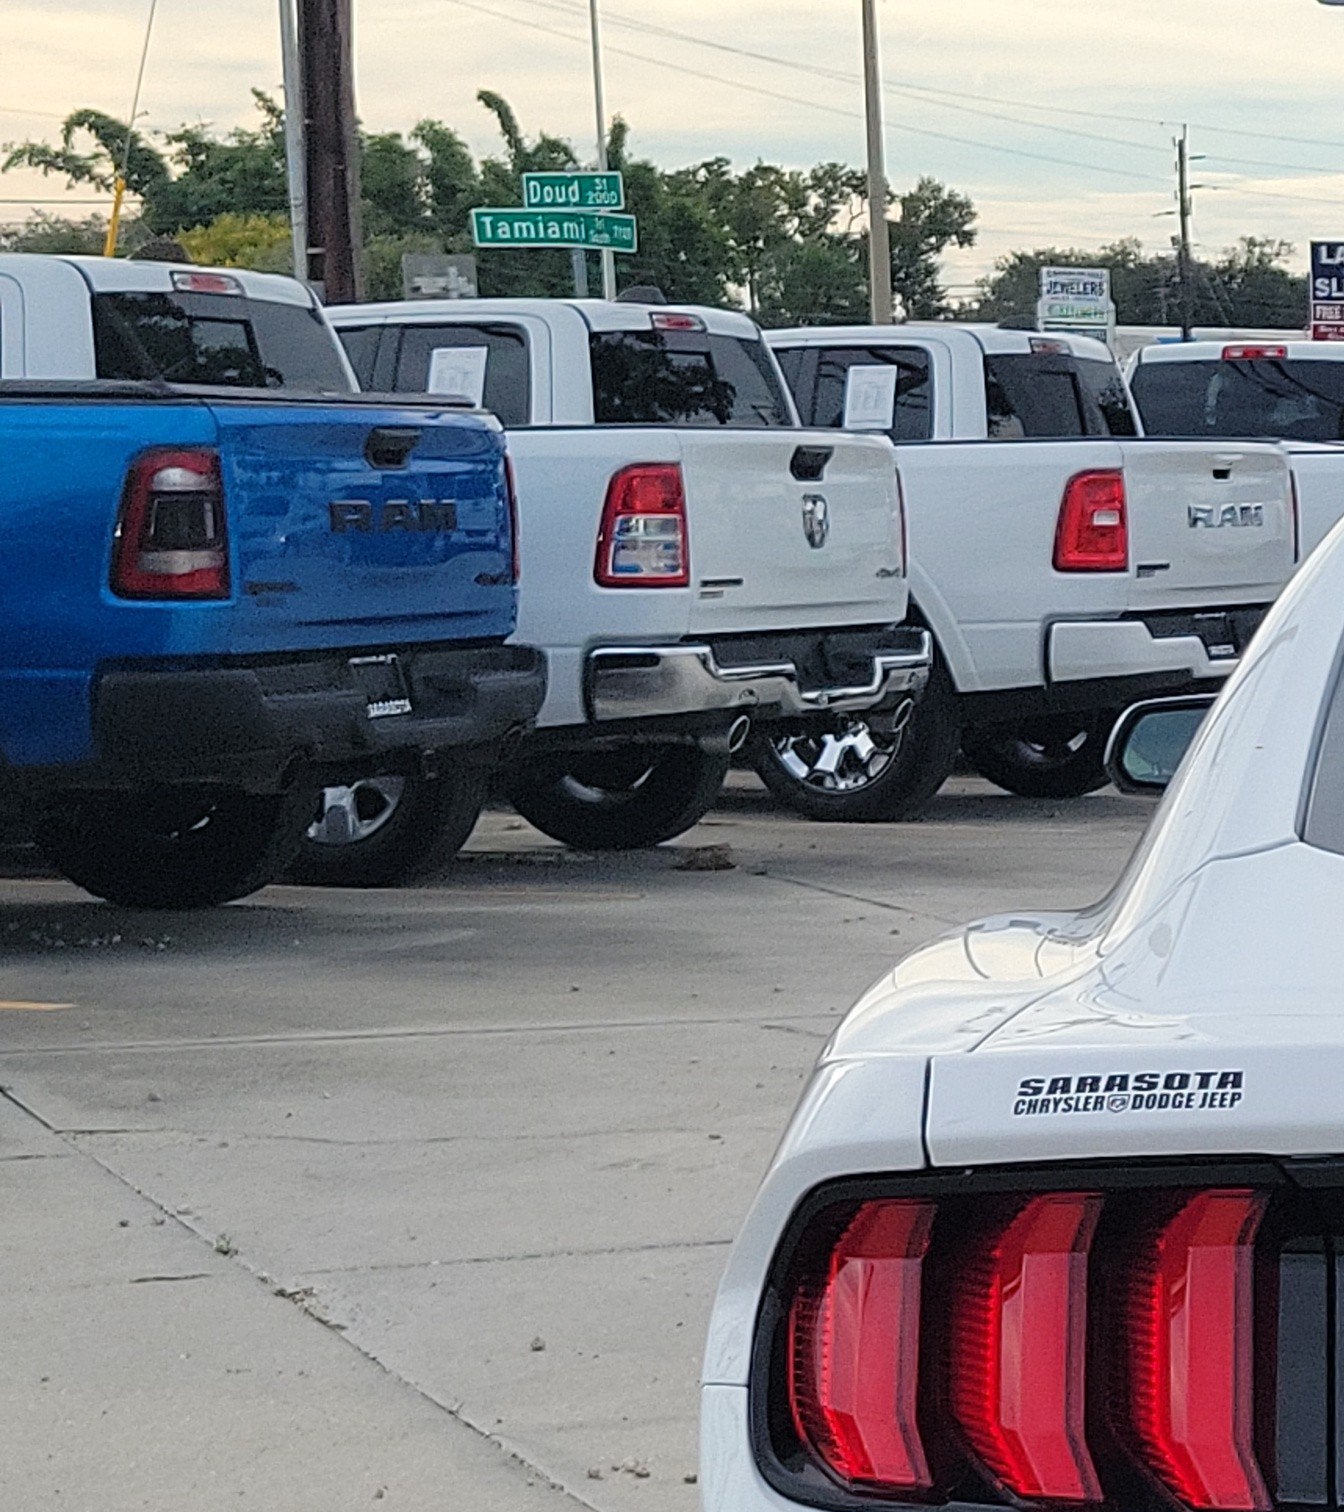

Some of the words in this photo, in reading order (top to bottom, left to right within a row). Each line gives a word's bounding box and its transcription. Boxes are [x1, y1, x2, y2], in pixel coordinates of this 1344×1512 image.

[528, 180, 580, 203] Doud
[480, 216, 586, 239] Tamiami
[328, 499, 458, 533] RAM
[1187, 503, 1263, 528] RAM
[1016, 1070, 1244, 1097] SARASOTA
[1013, 1095, 1105, 1116] CHRYSLER
[1130, 1092, 1194, 1110] DODGE
[1198, 1091, 1242, 1109] JEEP
